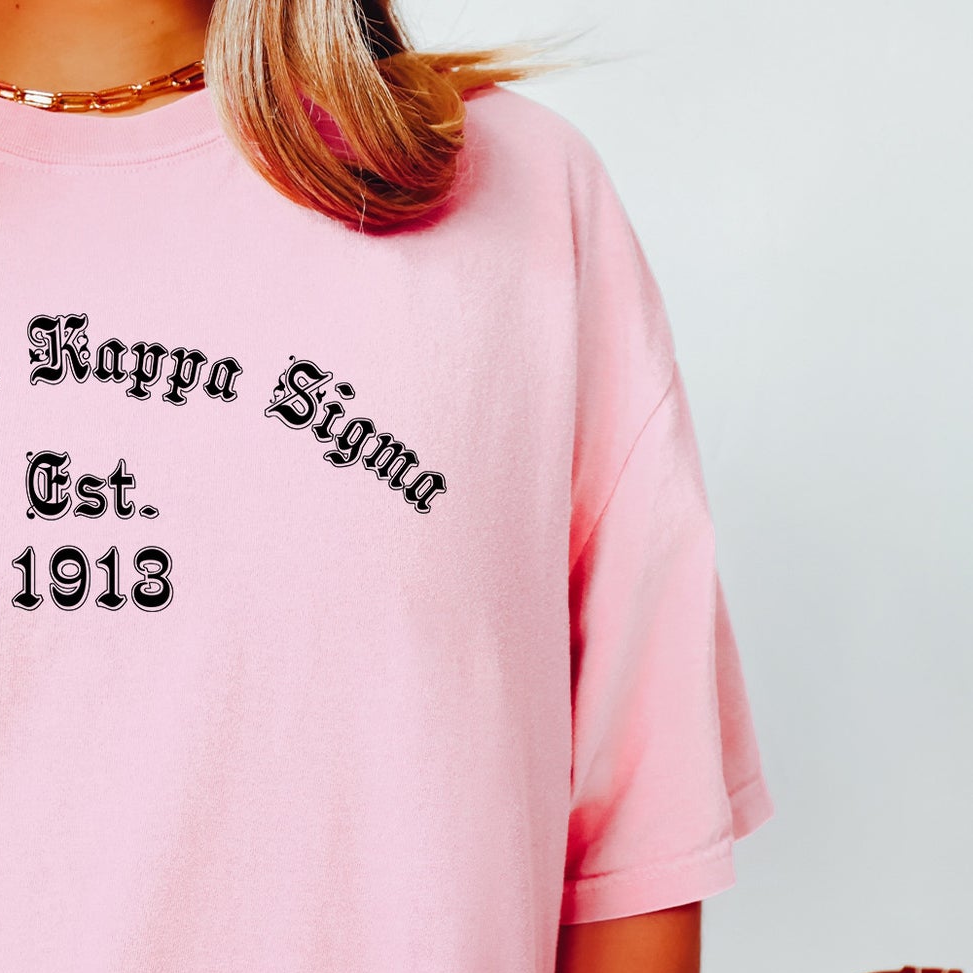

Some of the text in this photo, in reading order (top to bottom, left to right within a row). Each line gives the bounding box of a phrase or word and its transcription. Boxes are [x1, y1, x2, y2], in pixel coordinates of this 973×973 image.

[27, 313, 243, 406] Kappa
[264, 355, 447, 514] Sigma
[25, 450, 160, 520] Est.
[12, 545, 174, 612] 1913
